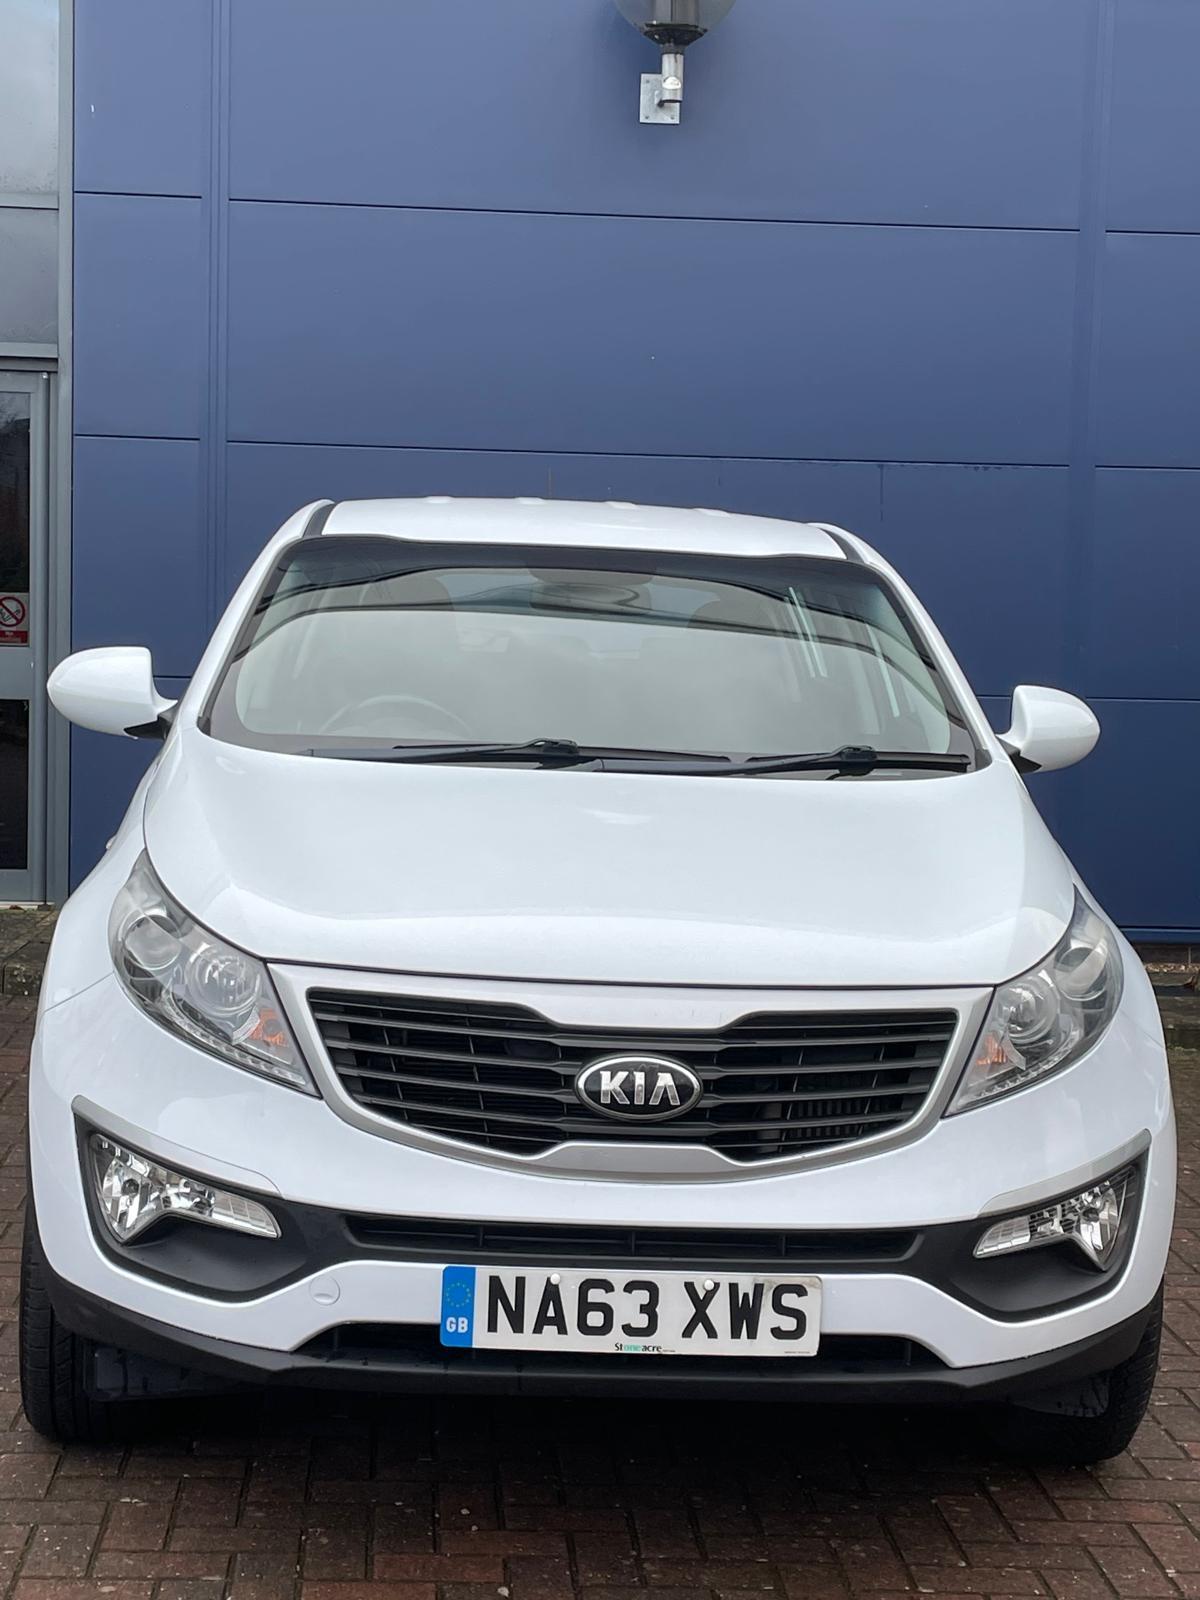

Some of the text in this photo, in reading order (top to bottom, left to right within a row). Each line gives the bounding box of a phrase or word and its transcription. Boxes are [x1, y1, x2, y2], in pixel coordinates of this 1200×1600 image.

[600, 1071, 681, 1106] KIA
[487, 1275, 808, 1341] NA63 XWS
[445, 1316, 469, 1333] GB
[614, 1342, 663, 1353] Stoneacre
